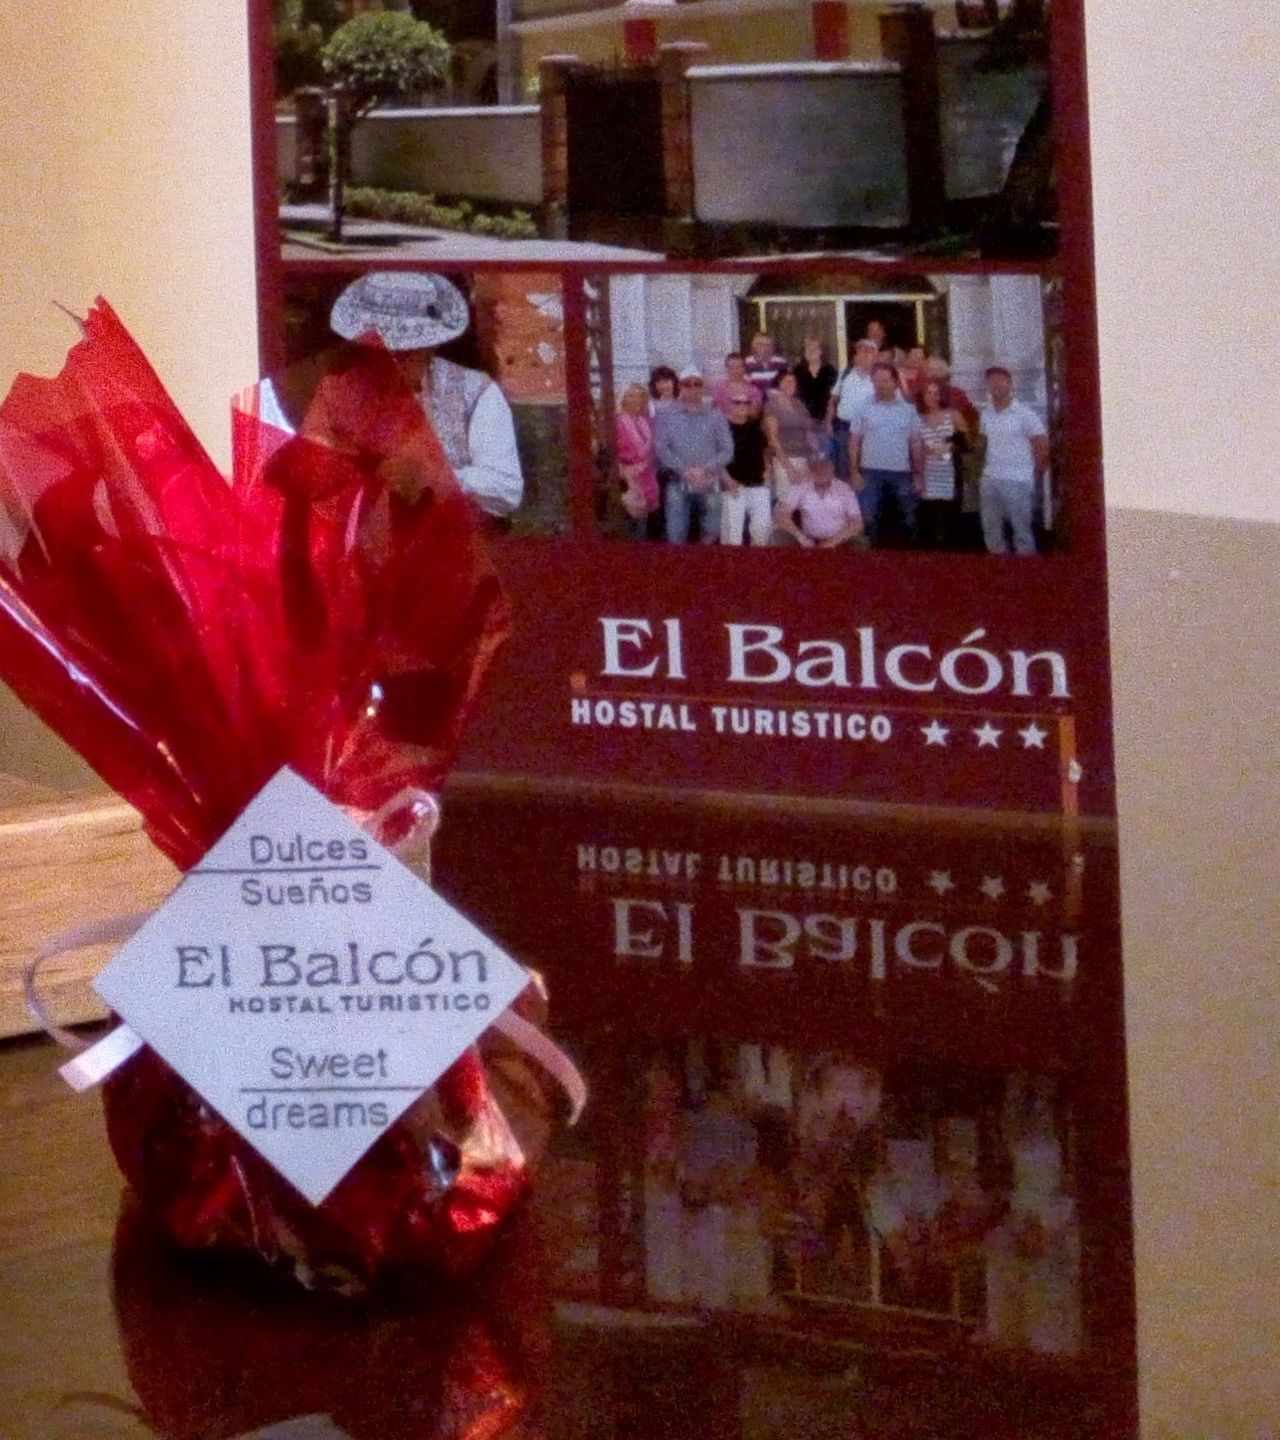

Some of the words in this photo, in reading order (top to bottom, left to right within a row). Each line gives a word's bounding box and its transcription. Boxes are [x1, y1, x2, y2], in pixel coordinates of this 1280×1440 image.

[597, 616, 687, 681] El
[723, 622, 1072, 699] Balcón
[570, 698, 697, 733] HOSTAL
[710, 705, 893, 742] TURISTICO
[249, 833, 370, 865] Dulces
[239, 877, 374, 907] Sueños
[174, 944, 233, 990] El
[259, 937, 491, 988] Balcón
[228, 995, 334, 1015] HOSTAL
[340, 992, 492, 1014] TURISTICO
[268, 1046, 390, 1080] Sweet
[244, 1094, 390, 1130] dreams
